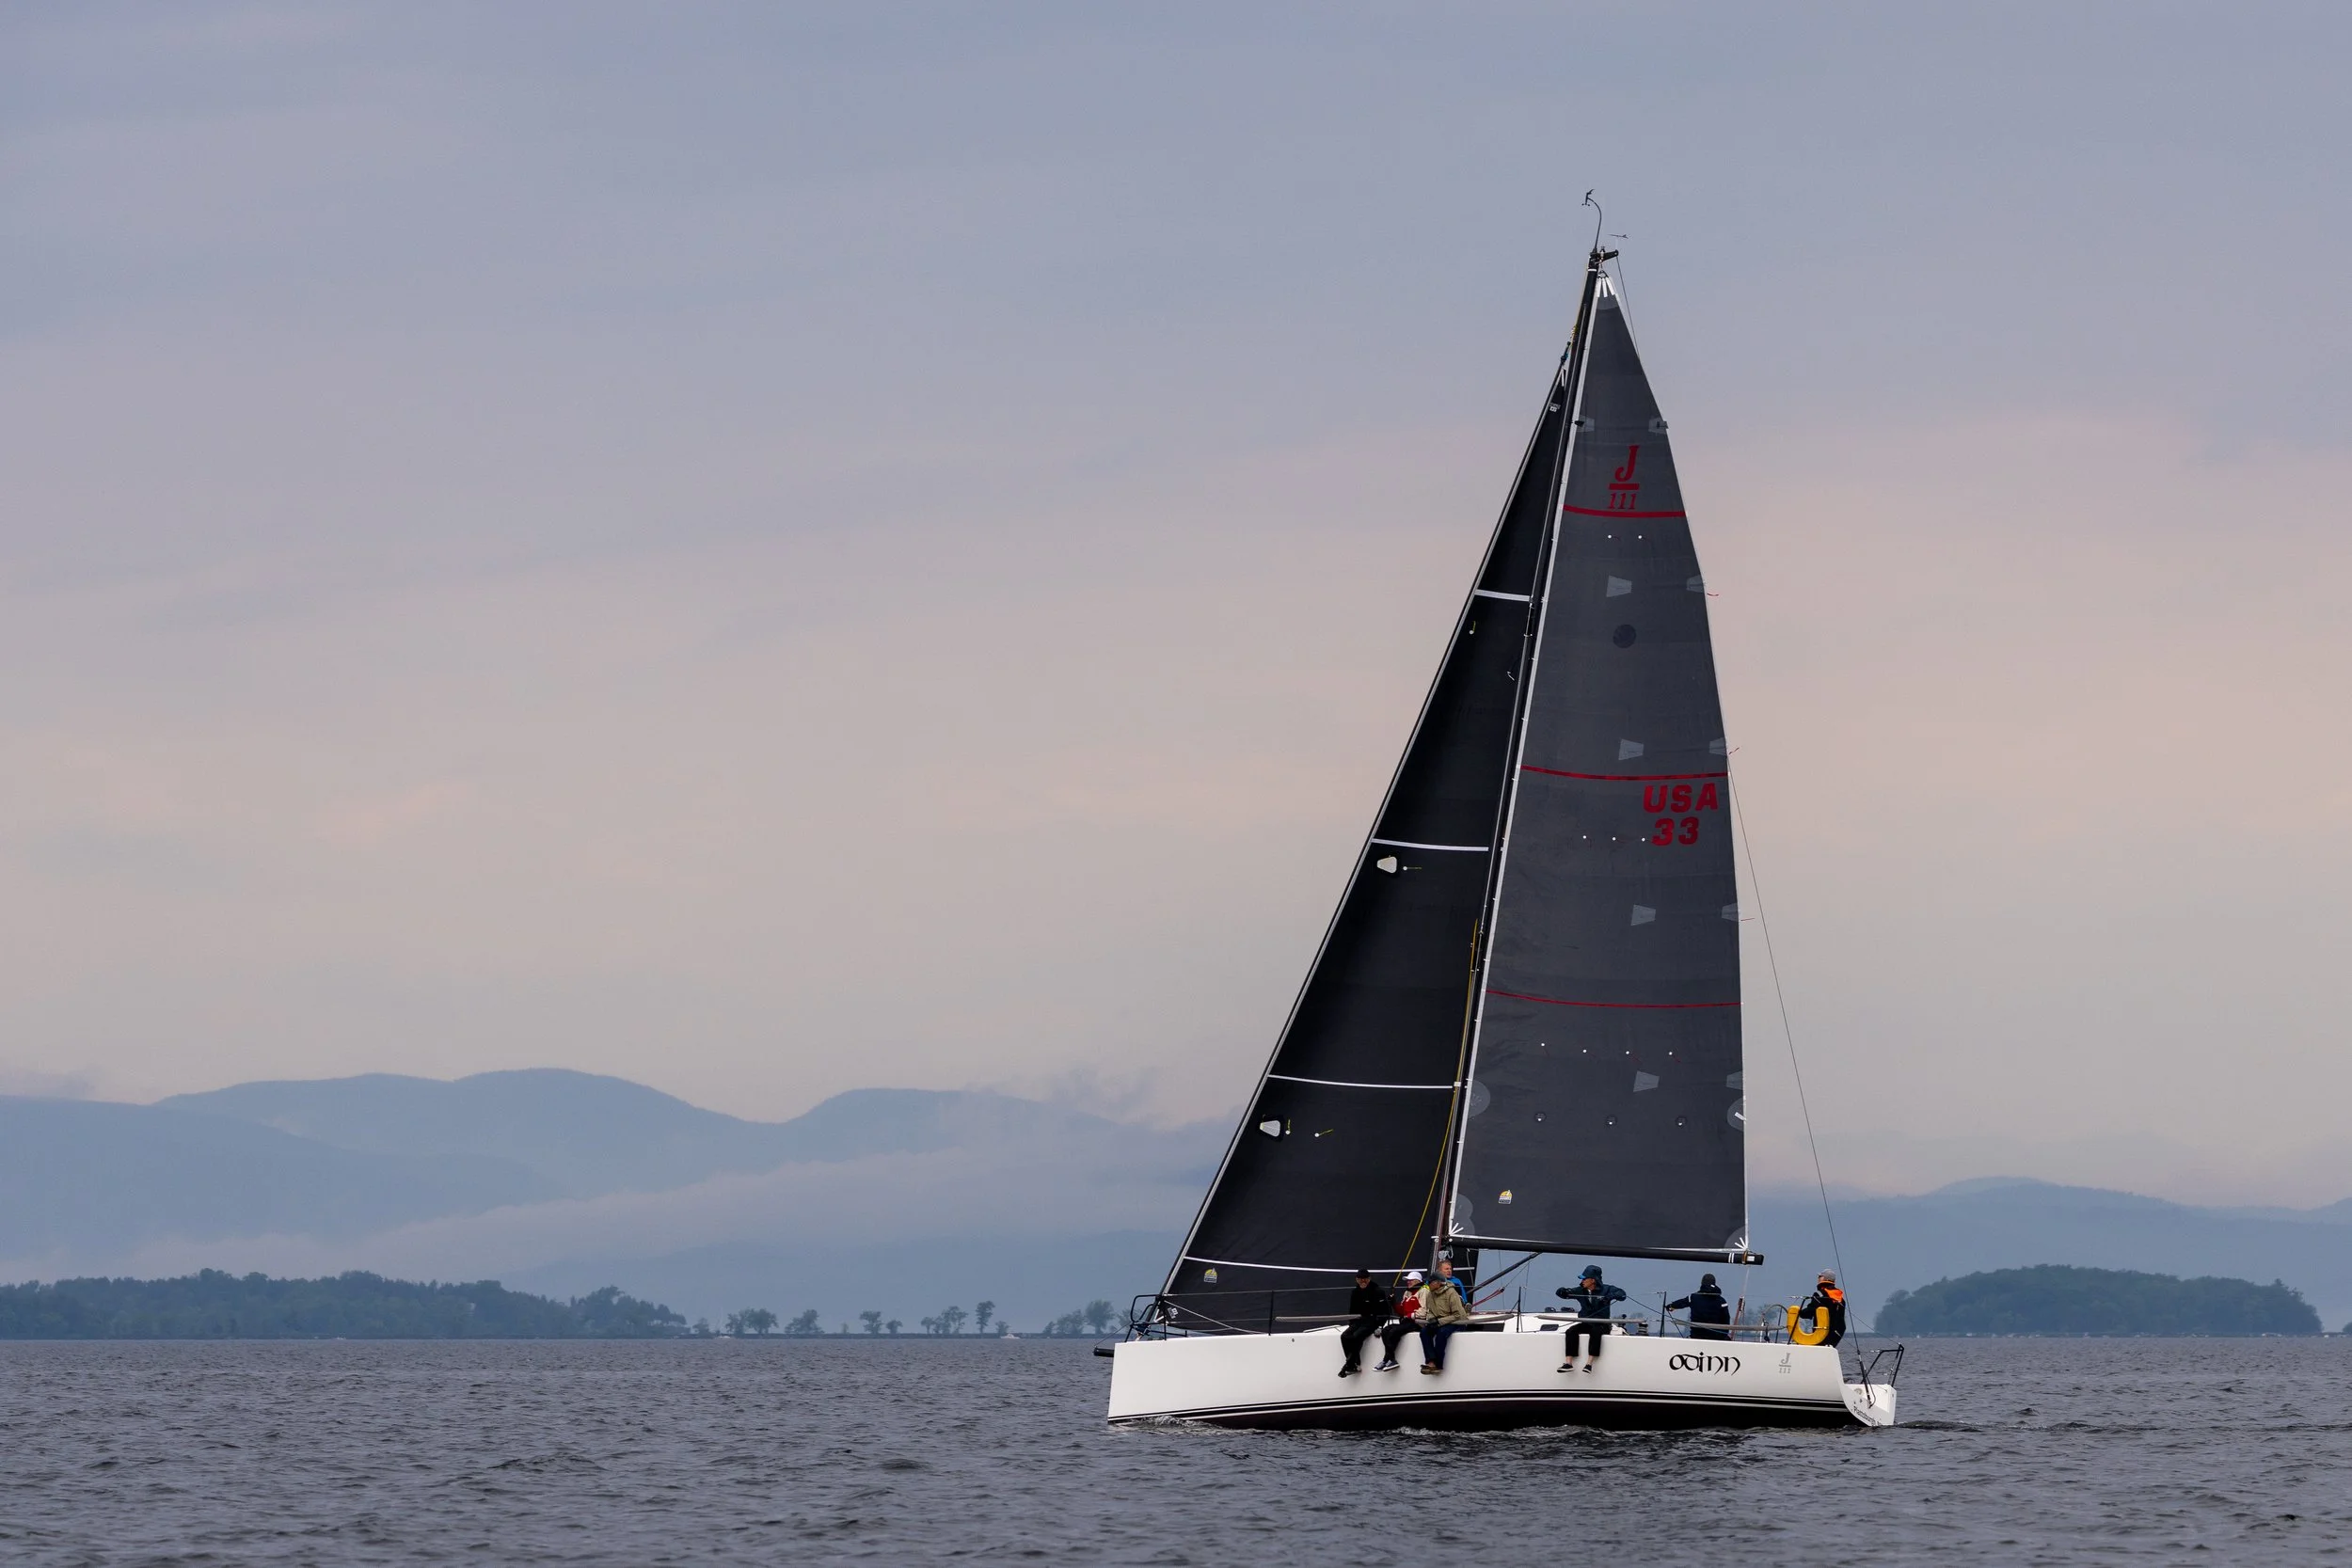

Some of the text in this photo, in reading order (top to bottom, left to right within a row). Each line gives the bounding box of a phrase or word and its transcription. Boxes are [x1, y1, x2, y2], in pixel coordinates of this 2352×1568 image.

[1614, 445, 1640, 482] J
[1608, 493, 1636, 510] 111
[1643, 782, 1718, 814] USA
[1651, 816, 1699, 846] 33
